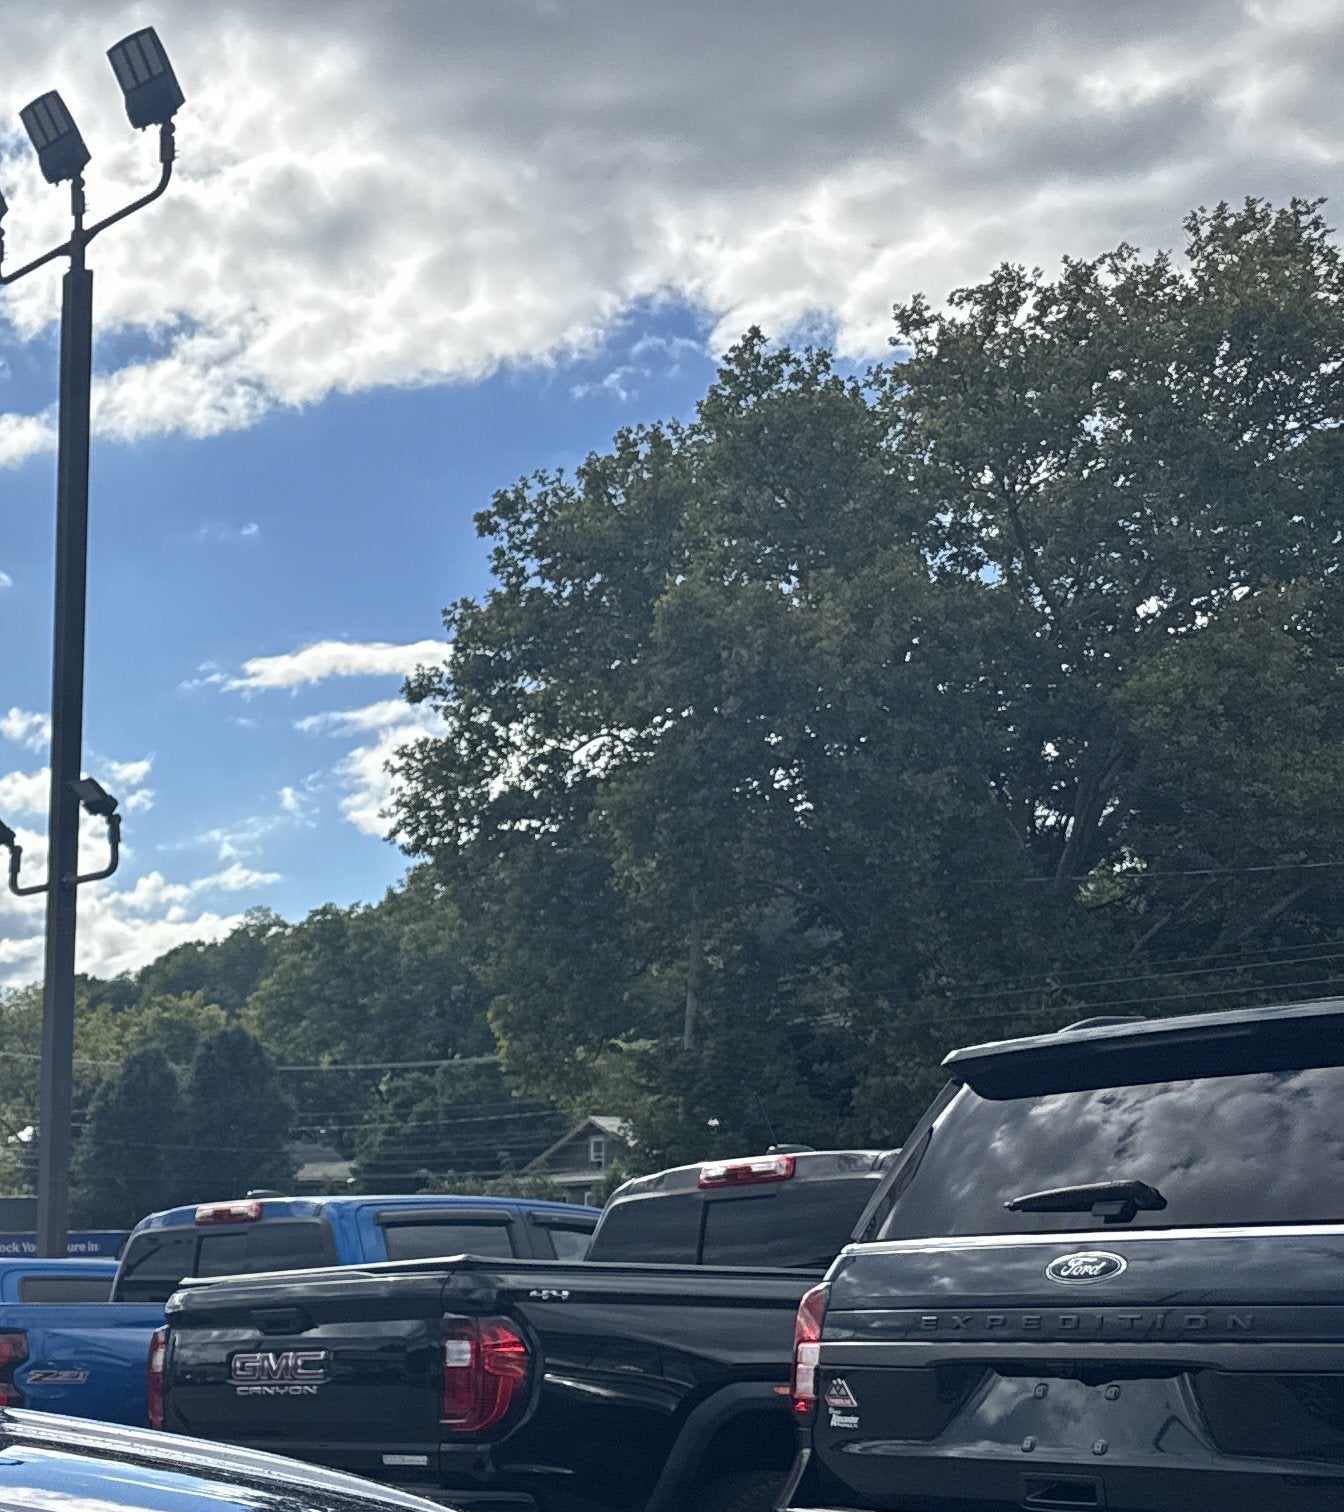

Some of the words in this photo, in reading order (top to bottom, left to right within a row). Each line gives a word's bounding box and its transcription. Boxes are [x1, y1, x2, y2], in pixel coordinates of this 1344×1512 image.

[21, 1241, 36, 1253] Yo
[1060, 1257, 1107, 1276] Ford
[920, 1314, 1255, 1332] EXPEDITION
[231, 1350, 326, 1381] GMC
[236, 1385, 319, 1396] CANYON
